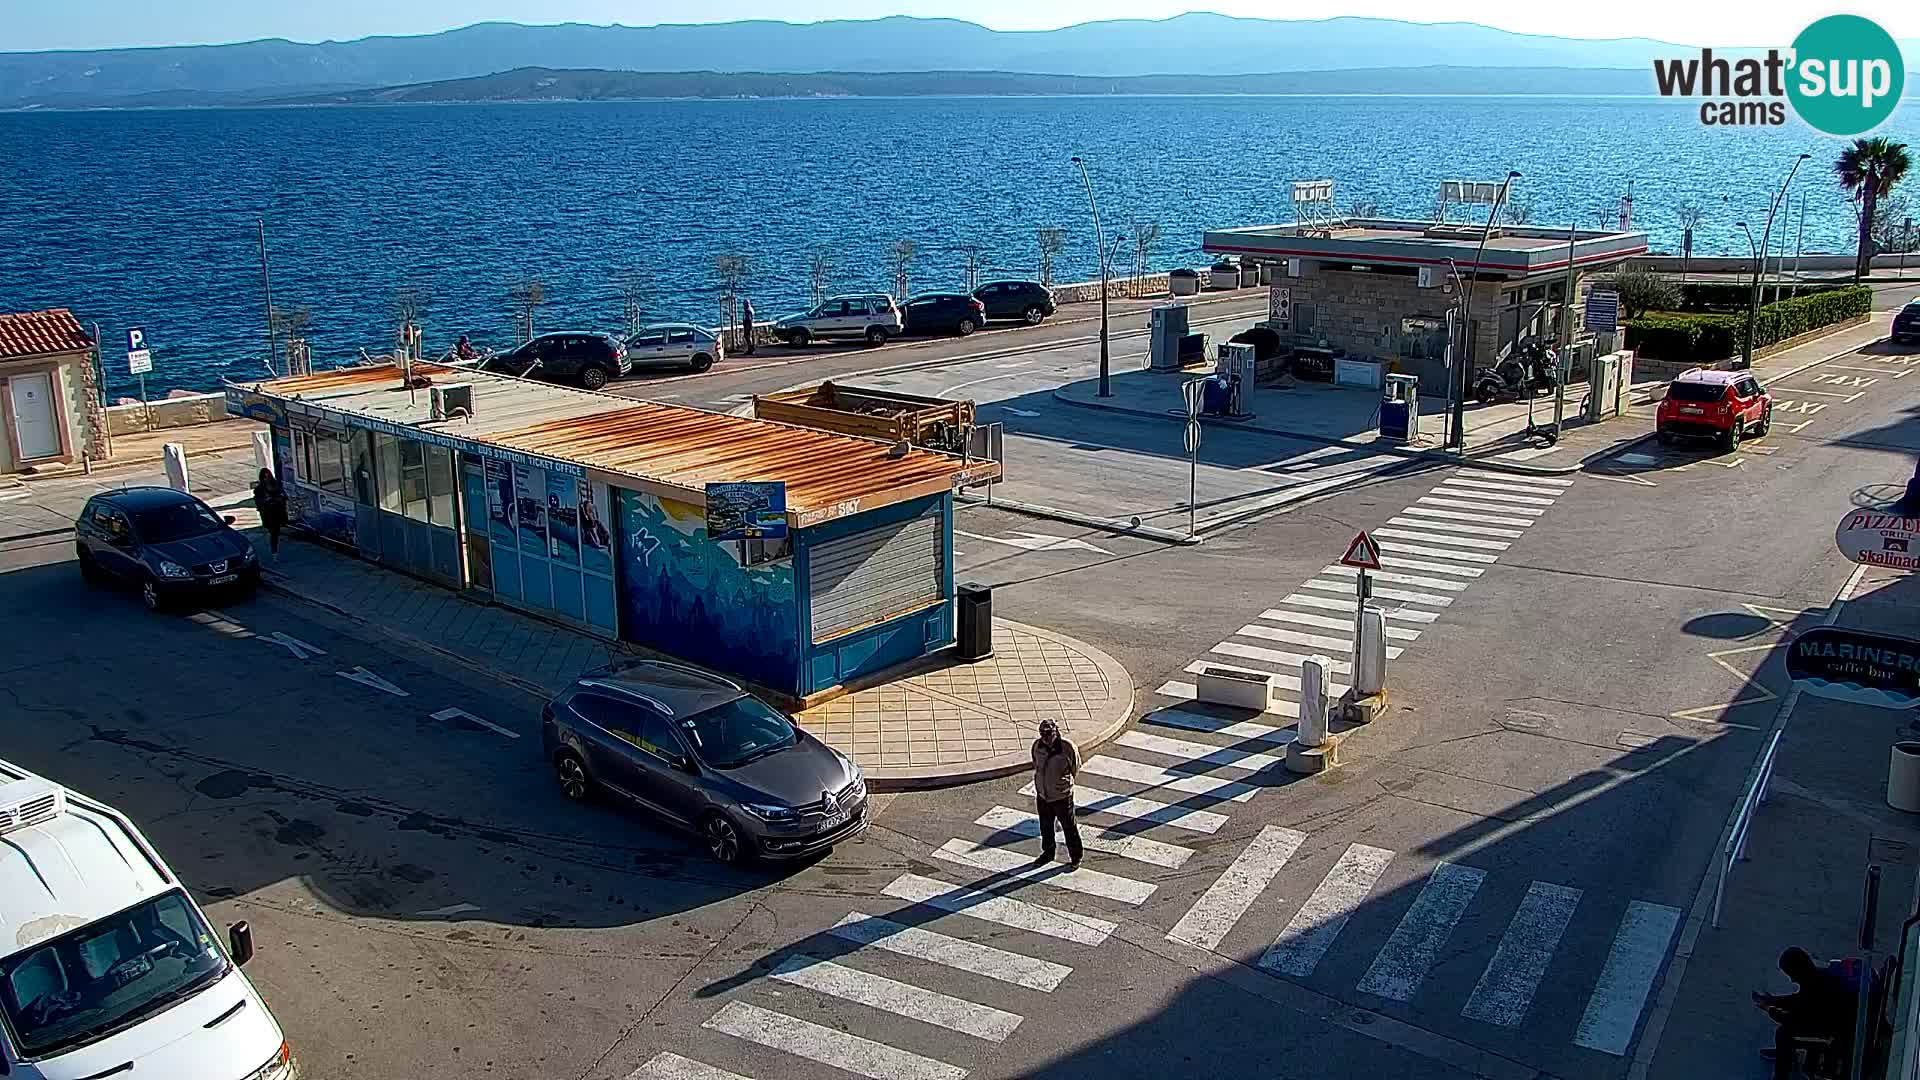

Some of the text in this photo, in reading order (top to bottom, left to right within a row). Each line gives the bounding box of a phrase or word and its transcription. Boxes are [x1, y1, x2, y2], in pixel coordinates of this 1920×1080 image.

[130, 330, 143, 348] P
[1812, 374, 1879, 387] TAXI
[1772, 399, 1828, 415] AXI
[478, 446, 582, 476] BUS STATION TICKET OFFICE
[1880, 530, 1912, 540] GRILL
[1827, 661, 1895, 680] caffe bar
